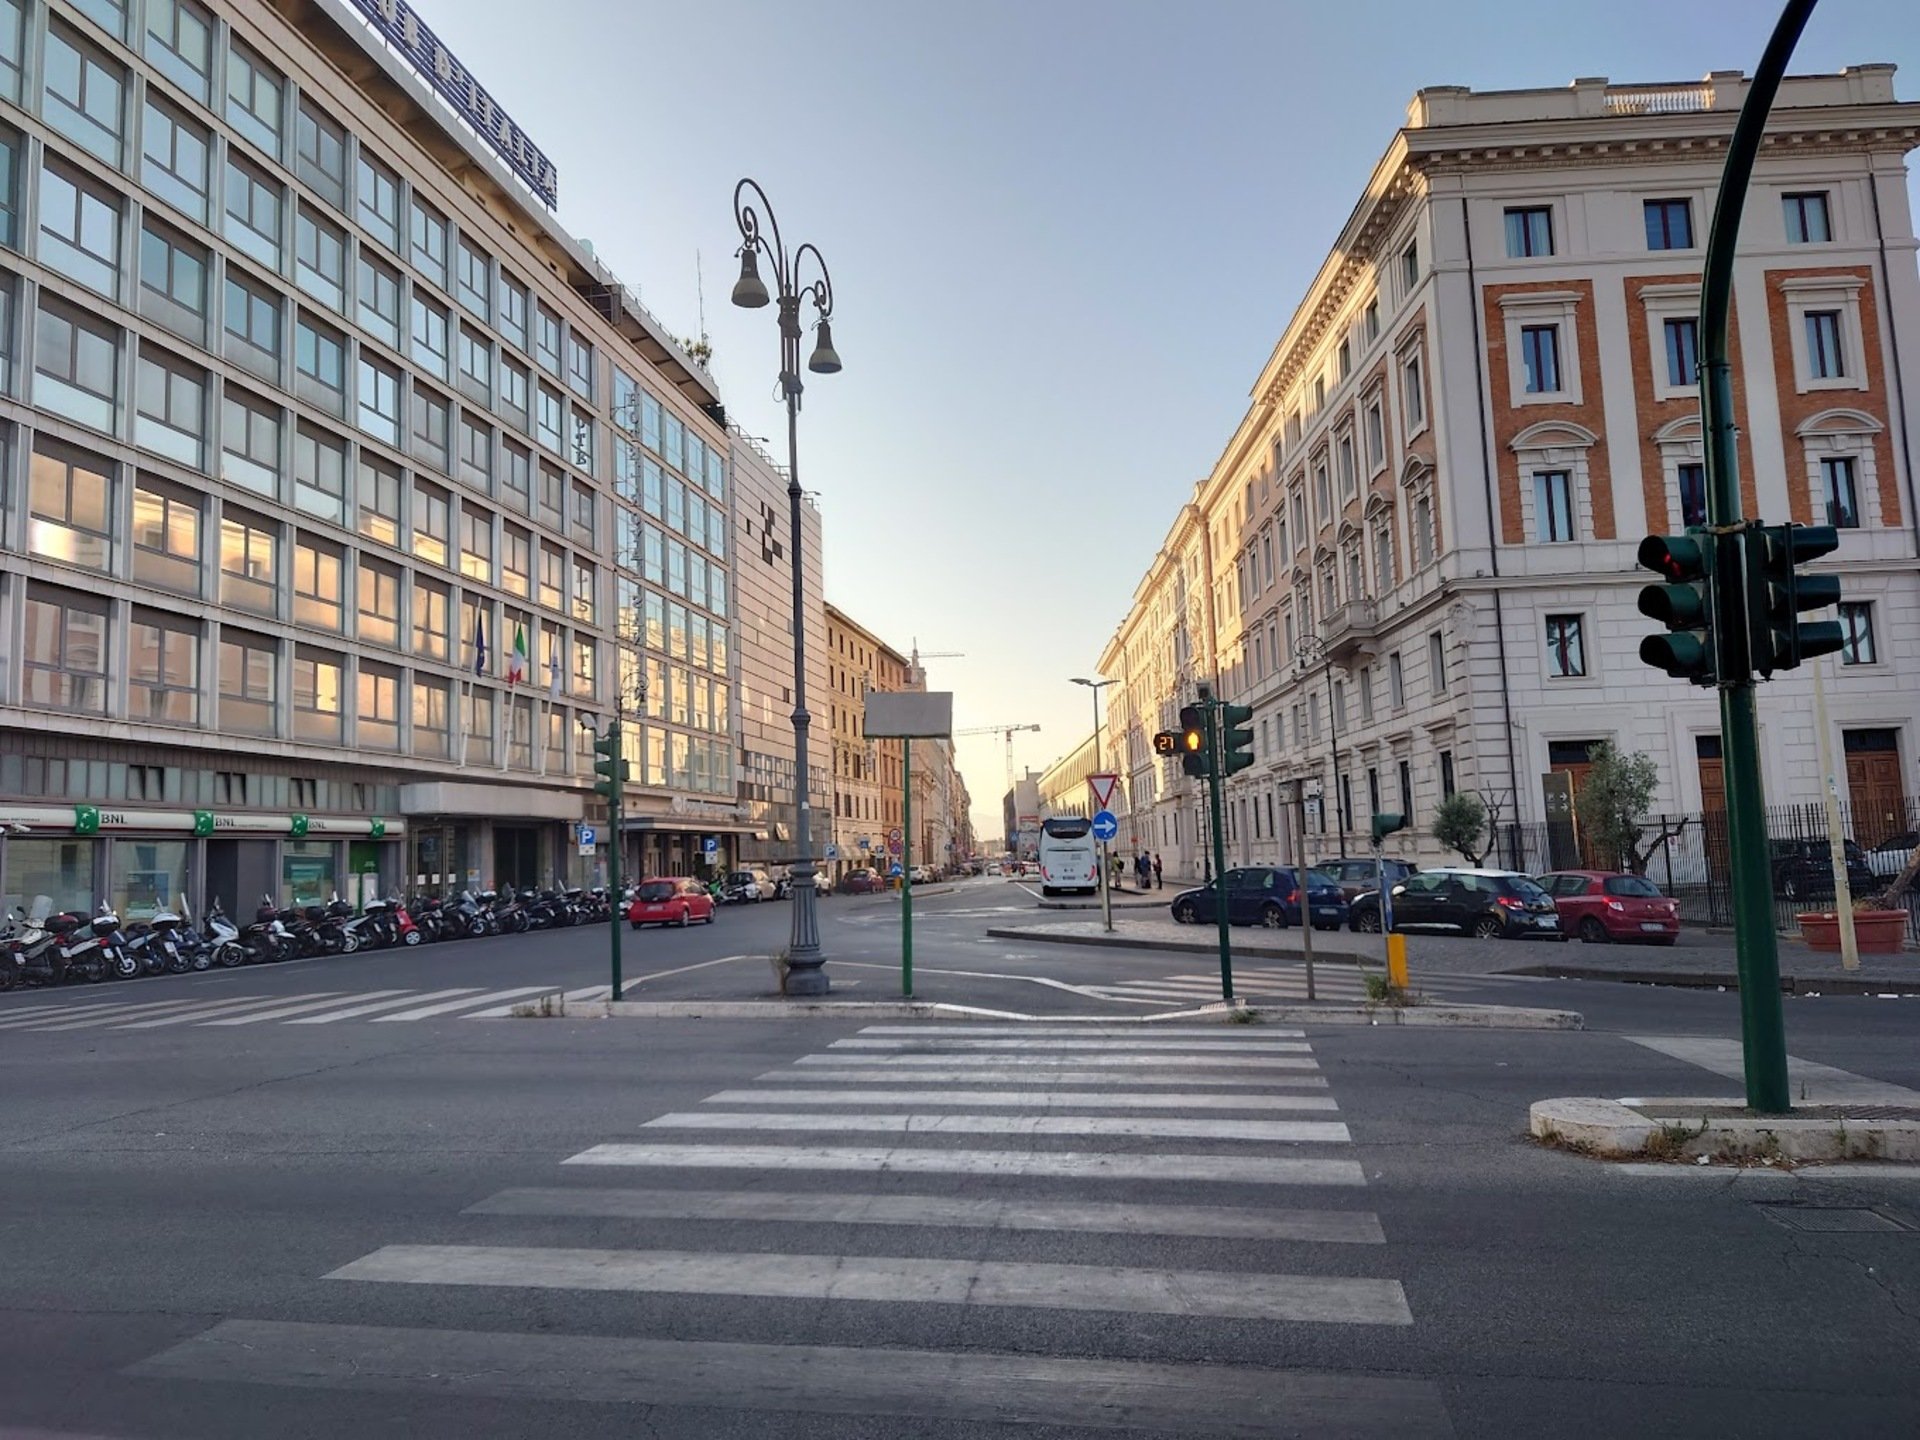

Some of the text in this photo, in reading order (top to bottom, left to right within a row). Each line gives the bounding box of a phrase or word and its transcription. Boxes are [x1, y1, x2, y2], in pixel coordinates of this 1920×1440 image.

[1159, 736, 1174, 750] 27
[101, 814, 128, 824] BNL
[215, 817, 236, 827] BNL
[309, 820, 327, 829] BNL
[581, 830, 593, 844] P
[707, 839, 716, 851] P
